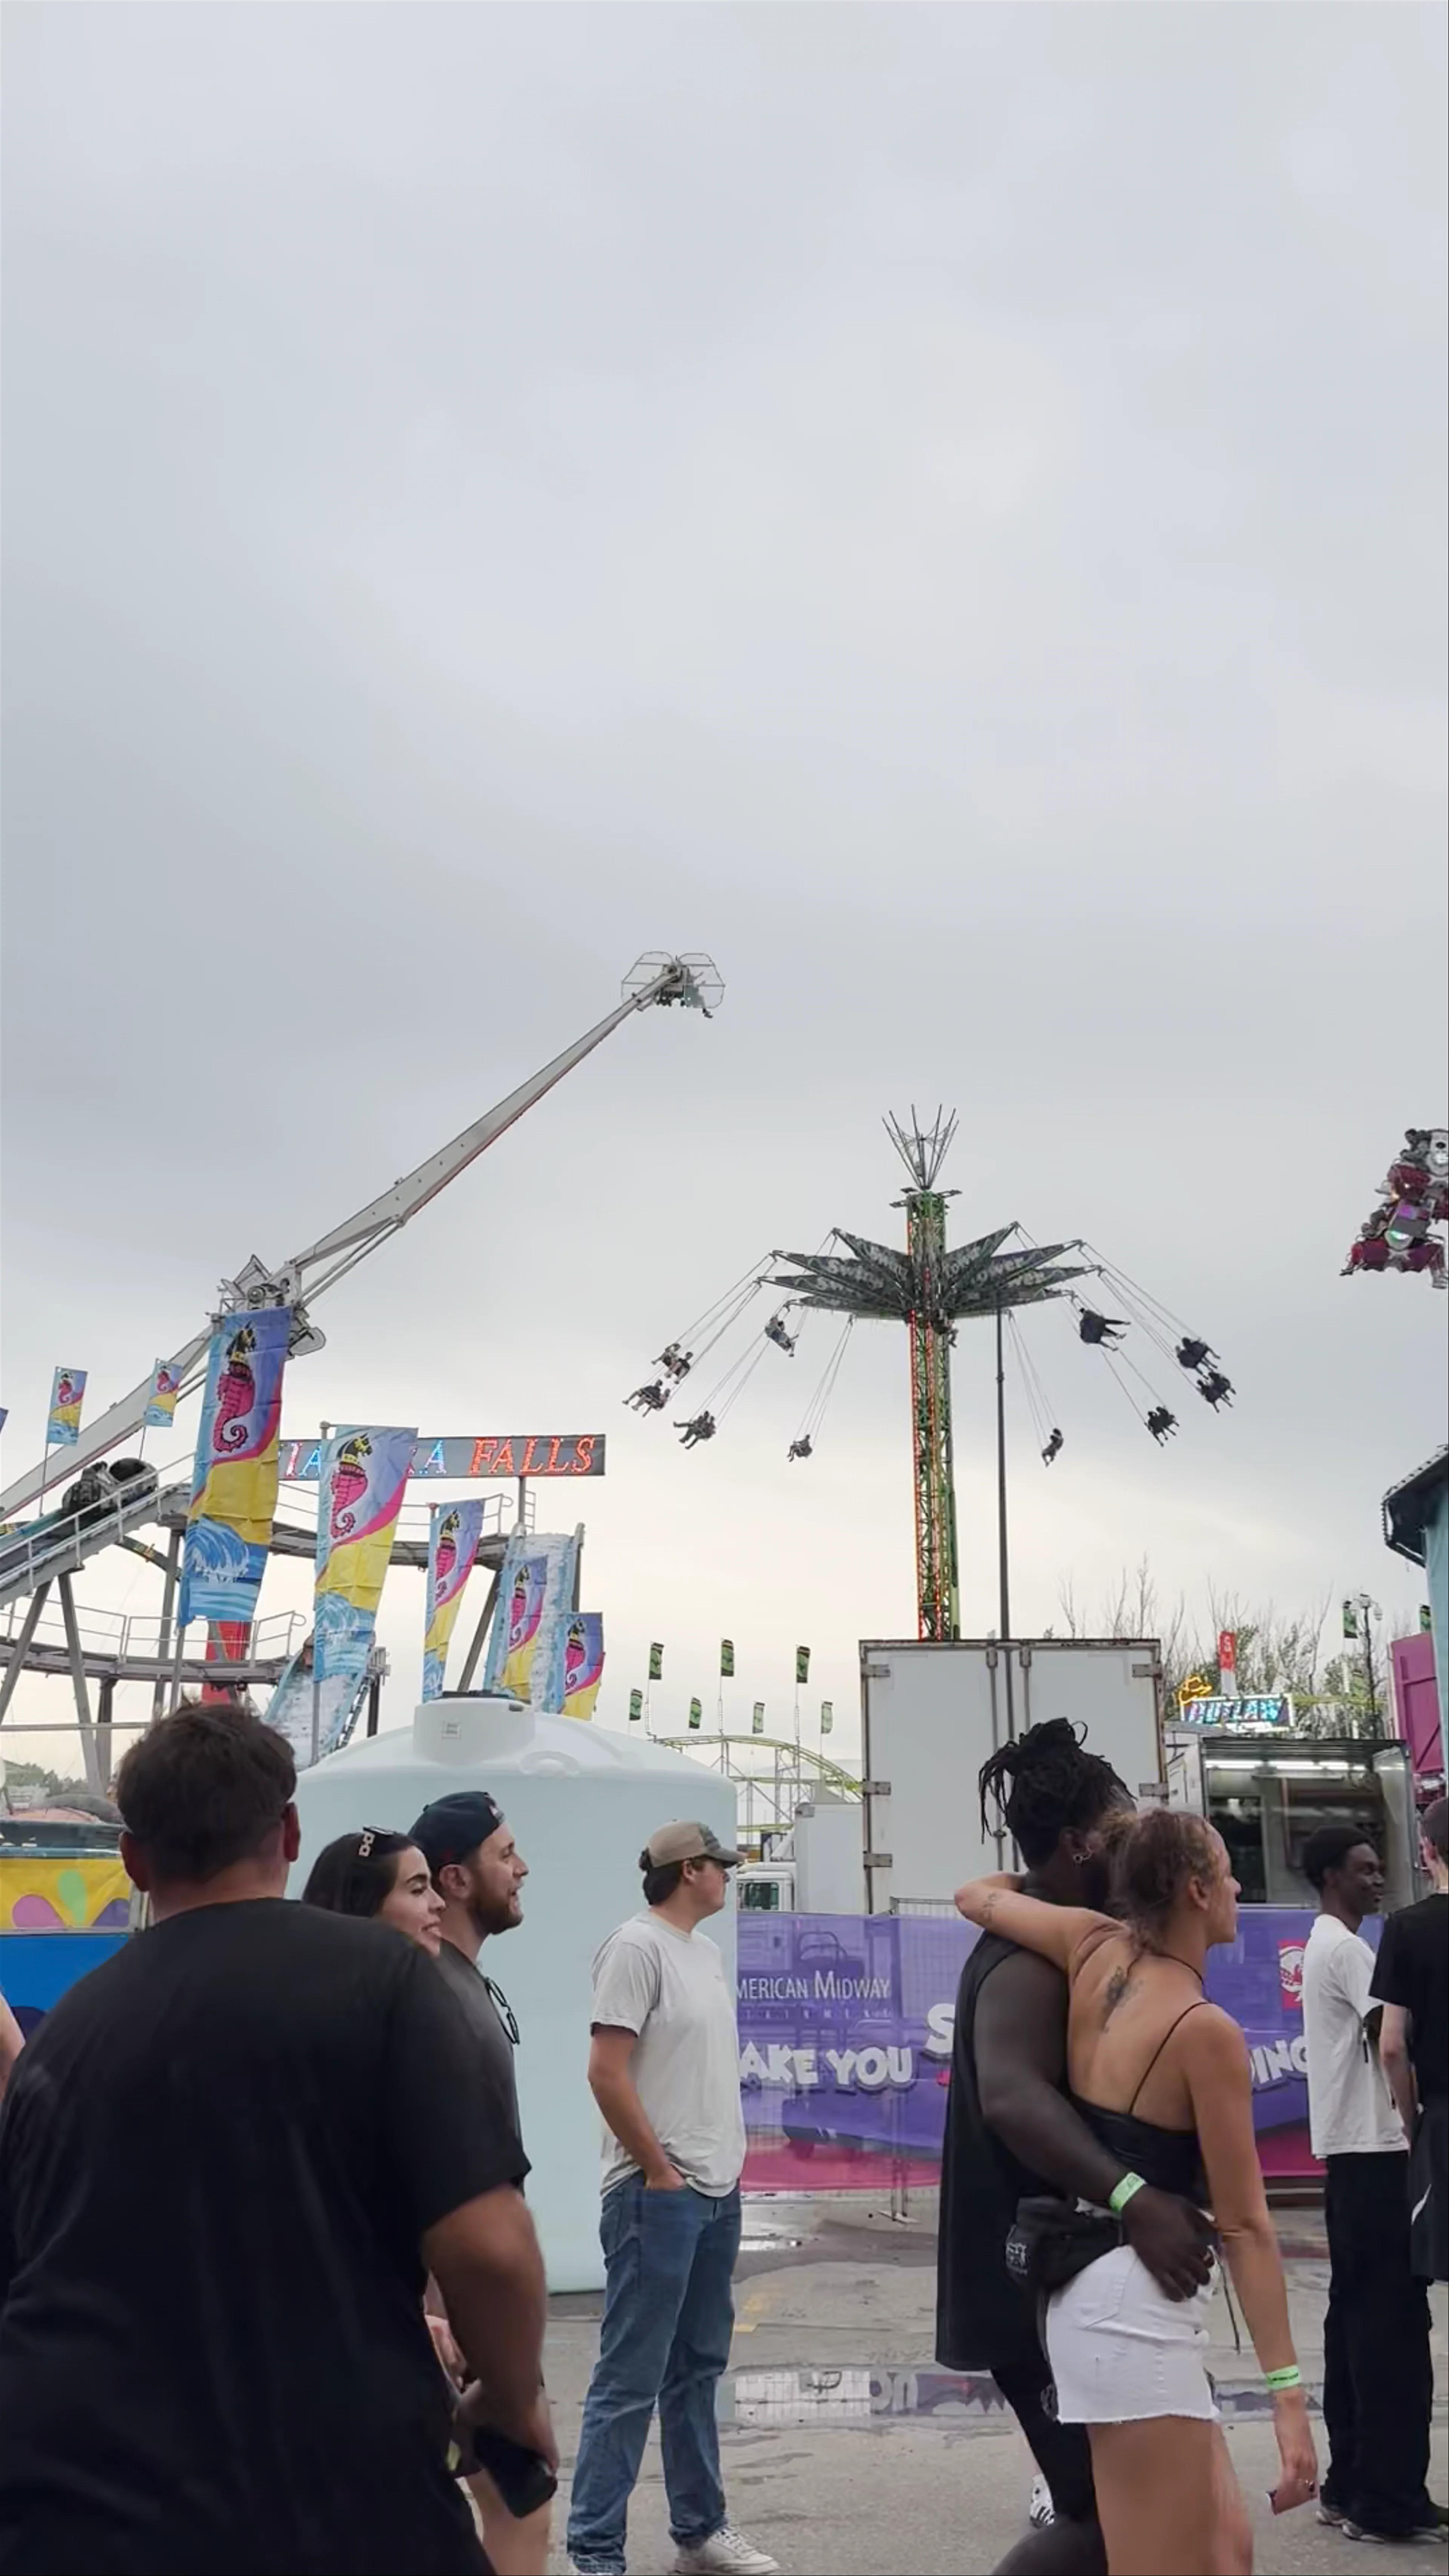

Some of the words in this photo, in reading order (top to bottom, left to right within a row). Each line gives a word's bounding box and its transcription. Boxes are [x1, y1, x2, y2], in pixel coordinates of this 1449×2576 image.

[469, 1435, 595, 1476] FALLS
[736, 1977, 808, 1999] MERICAN
[814, 1970, 890, 1999] MIDWAY
[739, 2040, 818, 2084] AKE
[826, 2045, 912, 2085] YOU
